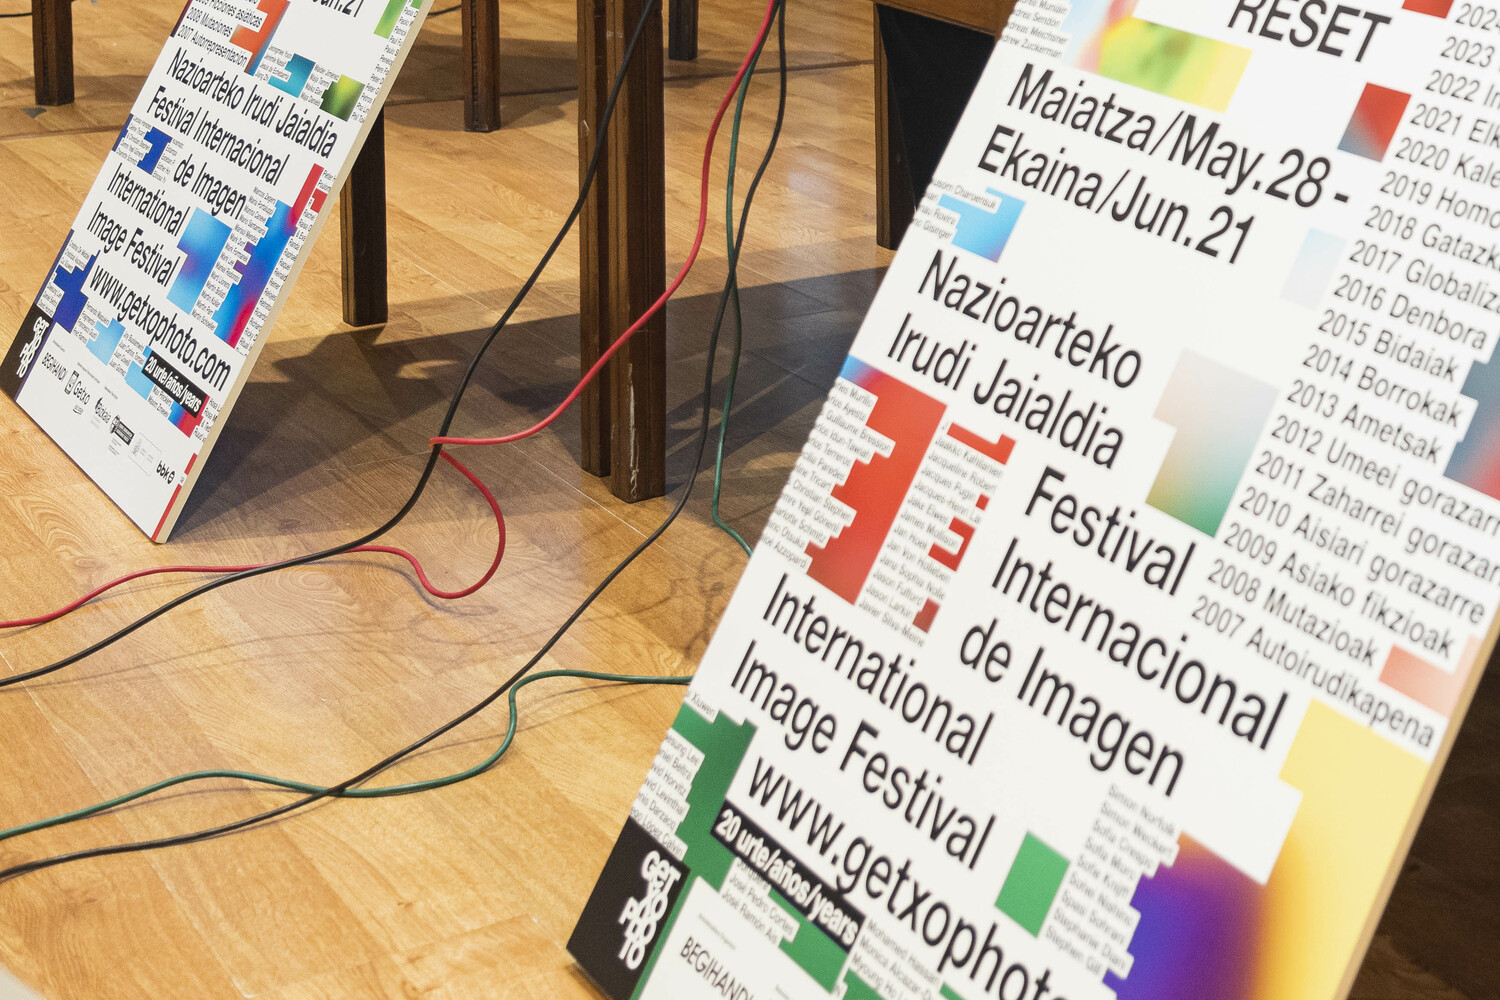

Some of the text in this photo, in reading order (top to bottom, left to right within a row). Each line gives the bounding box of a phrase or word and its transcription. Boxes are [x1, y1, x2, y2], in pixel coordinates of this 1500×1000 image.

[177, 24, 248, 67] 2007 Autorrepresentación
[1424, 69, 1481, 103] 2022
[1439, 35, 1495, 68] 2023
[147, 86, 201, 140] Festival
[192, 110, 291, 186] Internacional
[166, 47, 244, 109] Nazioarteko
[242, 84, 279, 134] Irudi
[276, 96, 338, 159] Jaialdia
[1006, 62, 1331, 208] Maiatza/May.28
[1409, 103, 1463, 136] 2021
[106, 162, 191, 237] International
[173, 153, 247, 220] de Imagen
[977, 124, 1255, 265] Ekaina/Jun.21
[1379, 170, 1433, 206] 2019
[1394, 136, 1450, 171] 2020
[86, 201, 181, 288] Image Festival
[1348, 239, 1403, 274] 2017
[1364, 205, 1418, 241] 2018
[89, 265, 232, 392] www.getxophoto.com
[917, 248, 1142, 389] Nazioarteko
[1317, 308, 1458, 383] 2015 Bidaiak
[42, 352, 68, 382] BEGIHANDI
[145, 355, 203, 413] 20 urte/años/years
[887, 312, 1124, 470] Irudi Jaialdia
[1270, 414, 1324, 455] 2012
[1326, 437, 1398, 489] Umeei
[1286, 379, 1441, 464] 2013 Ametsak
[1024, 466, 1196, 596] Festival
[991, 537, 1289, 751] Internacional
[1207, 558, 1377, 667] 2008 Mutazioak
[762, 572, 994, 766] International
[959, 618, 1184, 798] de Imagen
[1190, 594, 1435, 748] 2007 Autoirudikapena
[730, 639, 837, 754] Image
[839, 719, 996, 870] Festival
[714, 808, 861, 947] 20 urte/años/years
[749, 756, 1068, 1000] www.getxophot
